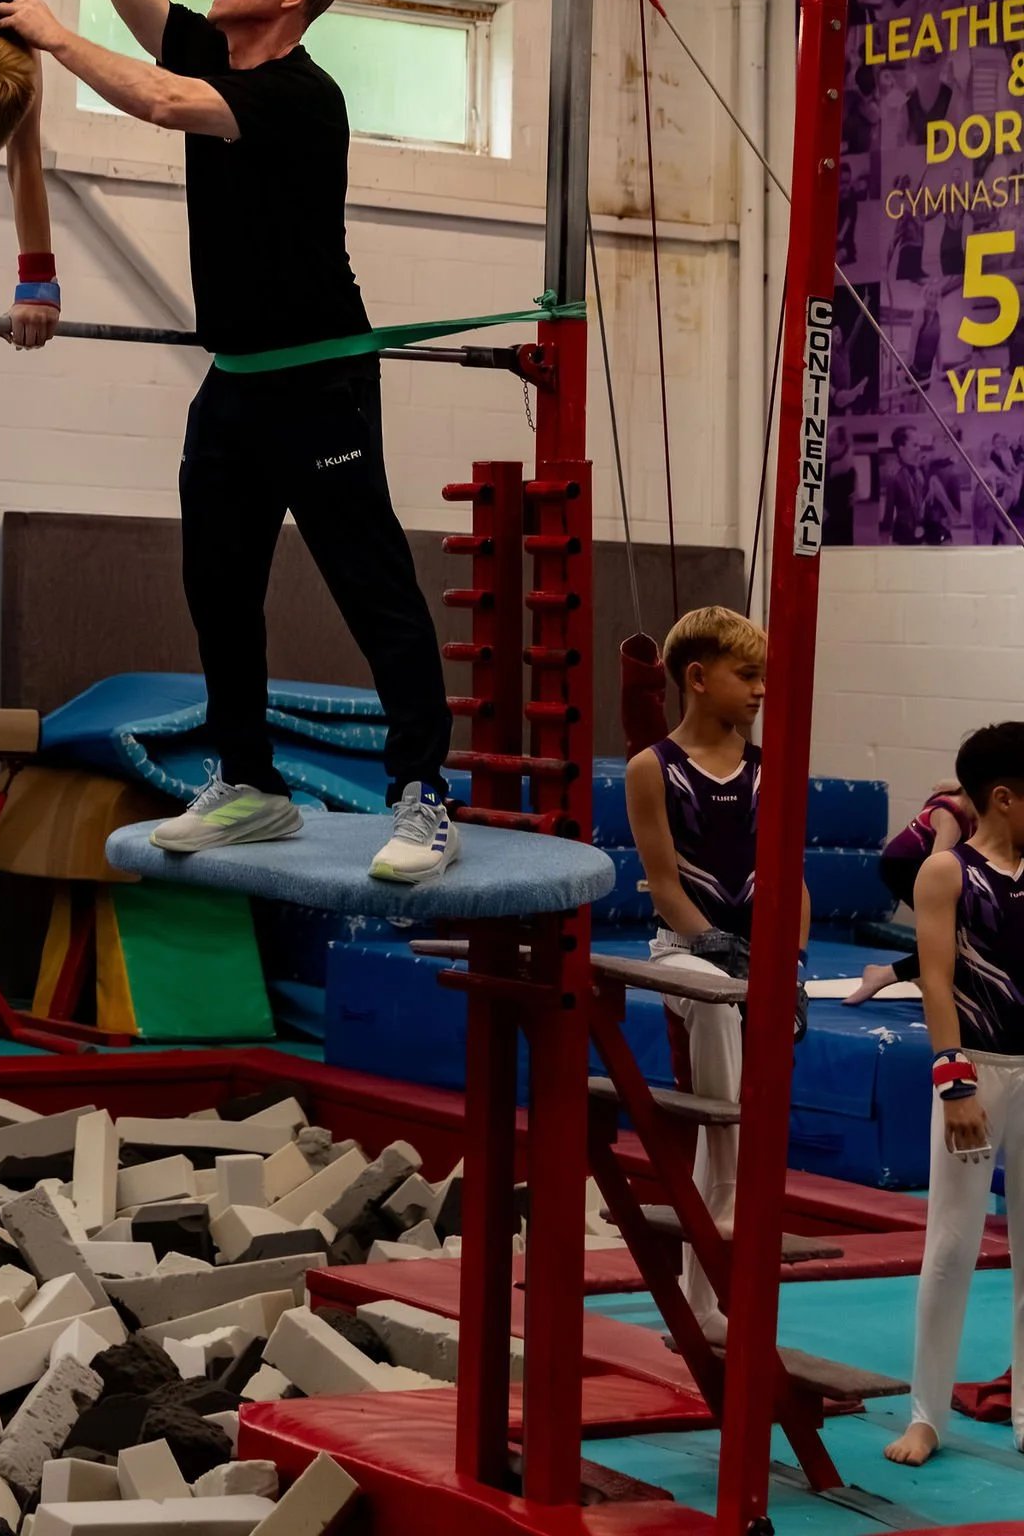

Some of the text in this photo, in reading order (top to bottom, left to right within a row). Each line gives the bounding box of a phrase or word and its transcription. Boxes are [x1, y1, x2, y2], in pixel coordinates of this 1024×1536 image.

[927, 110, 1022, 164] DOR
[885, 174, 1024, 219] GYMNAST
[957, 231, 1021, 347] 5
[946, 366, 1024, 414] YEA
[800, 300, 833, 547] CONTINENTAL
[324, 449, 362, 467] KUKRI
